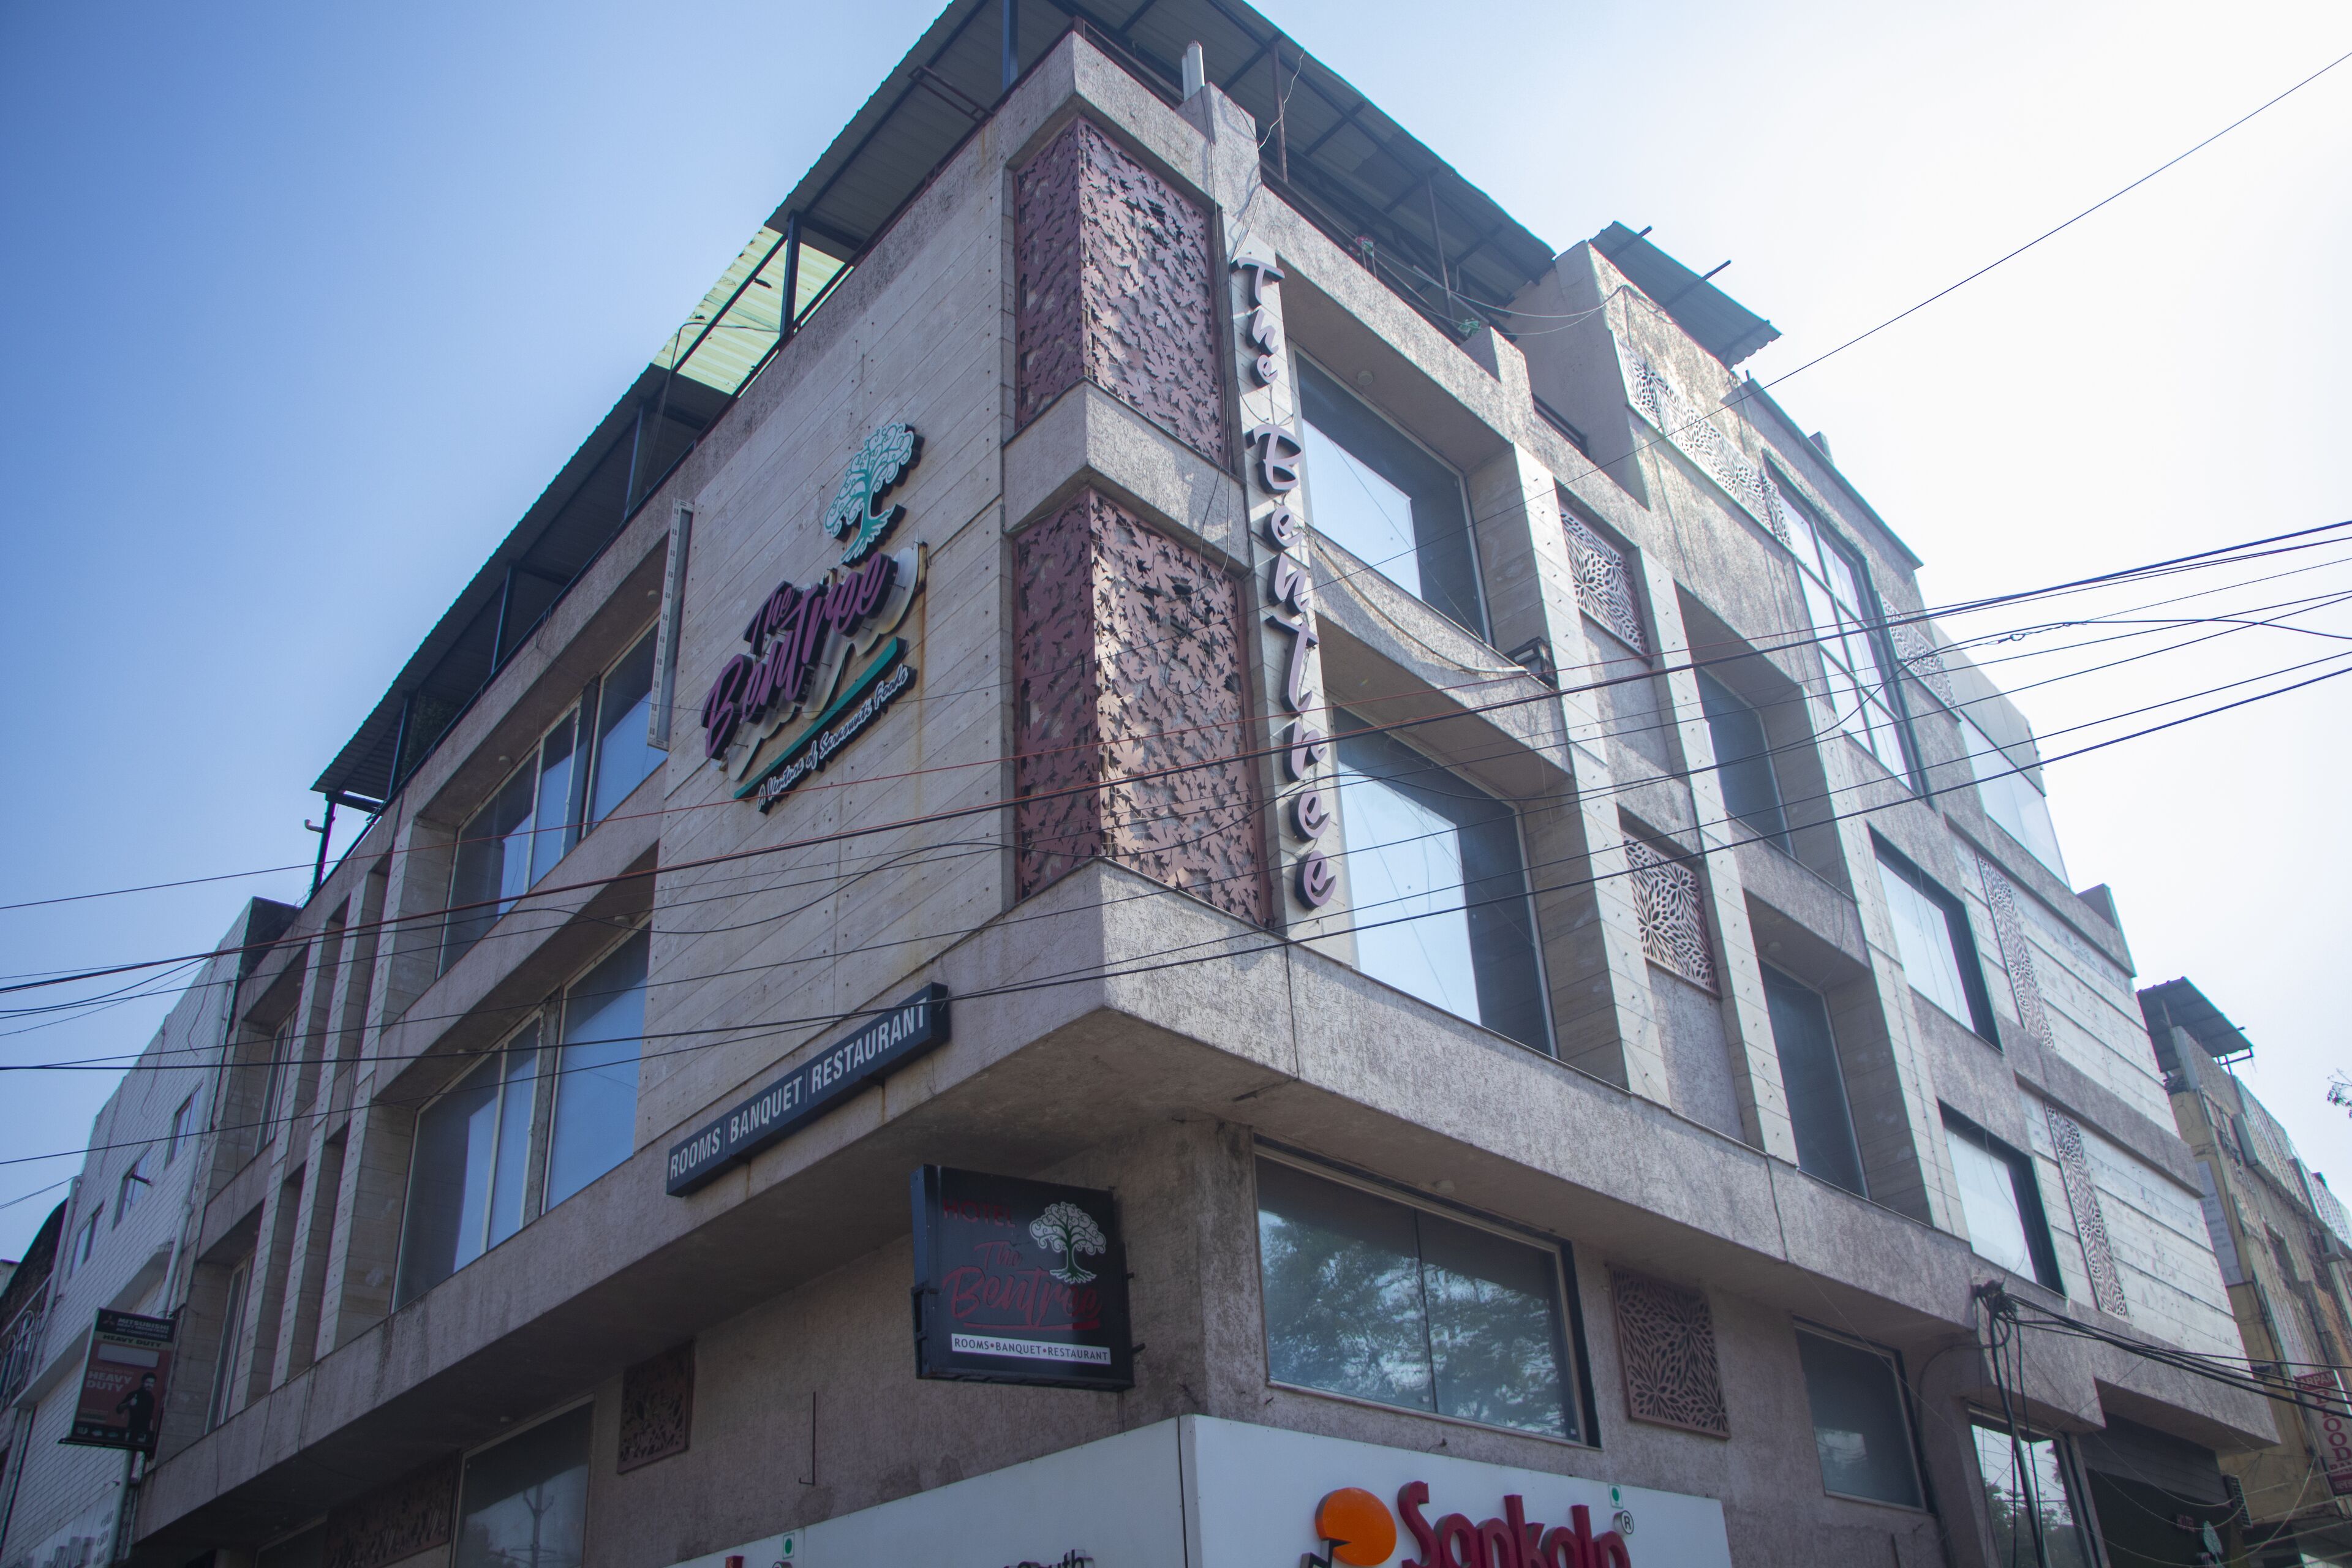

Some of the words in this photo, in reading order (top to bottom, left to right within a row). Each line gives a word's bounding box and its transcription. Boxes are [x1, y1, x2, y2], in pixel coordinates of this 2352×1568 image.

[1232, 257, 1285, 386] The
[745, 581, 794, 653] The
[767, 757, 805, 801] Venture
[805, 739, 819, 770] of
[819, 698, 873, 759] Saraswati
[873, 663, 910, 709] Foods
[669, 1126, 722, 1181] ROOMS
[729, 1075, 803, 1144] BANQUET
[810, 997, 929, 1094] RESTAURANT
[942, 1199, 1017, 1229] HOTEL
[974, 1240, 1023, 1271] The
[118, 1317, 170, 1330] MITSUBISHI
[103, 1334, 134, 1343] HEAVY
[136, 1339, 162, 1348] DUTY
[954, 1337, 990, 1351] ROOMS
[995, 1341, 1042, 1356] BANQUET
[1047, 1346, 1109, 1362] RESTAURANT
[86, 1379, 124, 1392] DUTY
[88, 1371, 133, 1384] HEAVY
[2300, 1372, 2336, 1389] ARPAN
[2315, 1390, 2352, 1461] BLOOD
